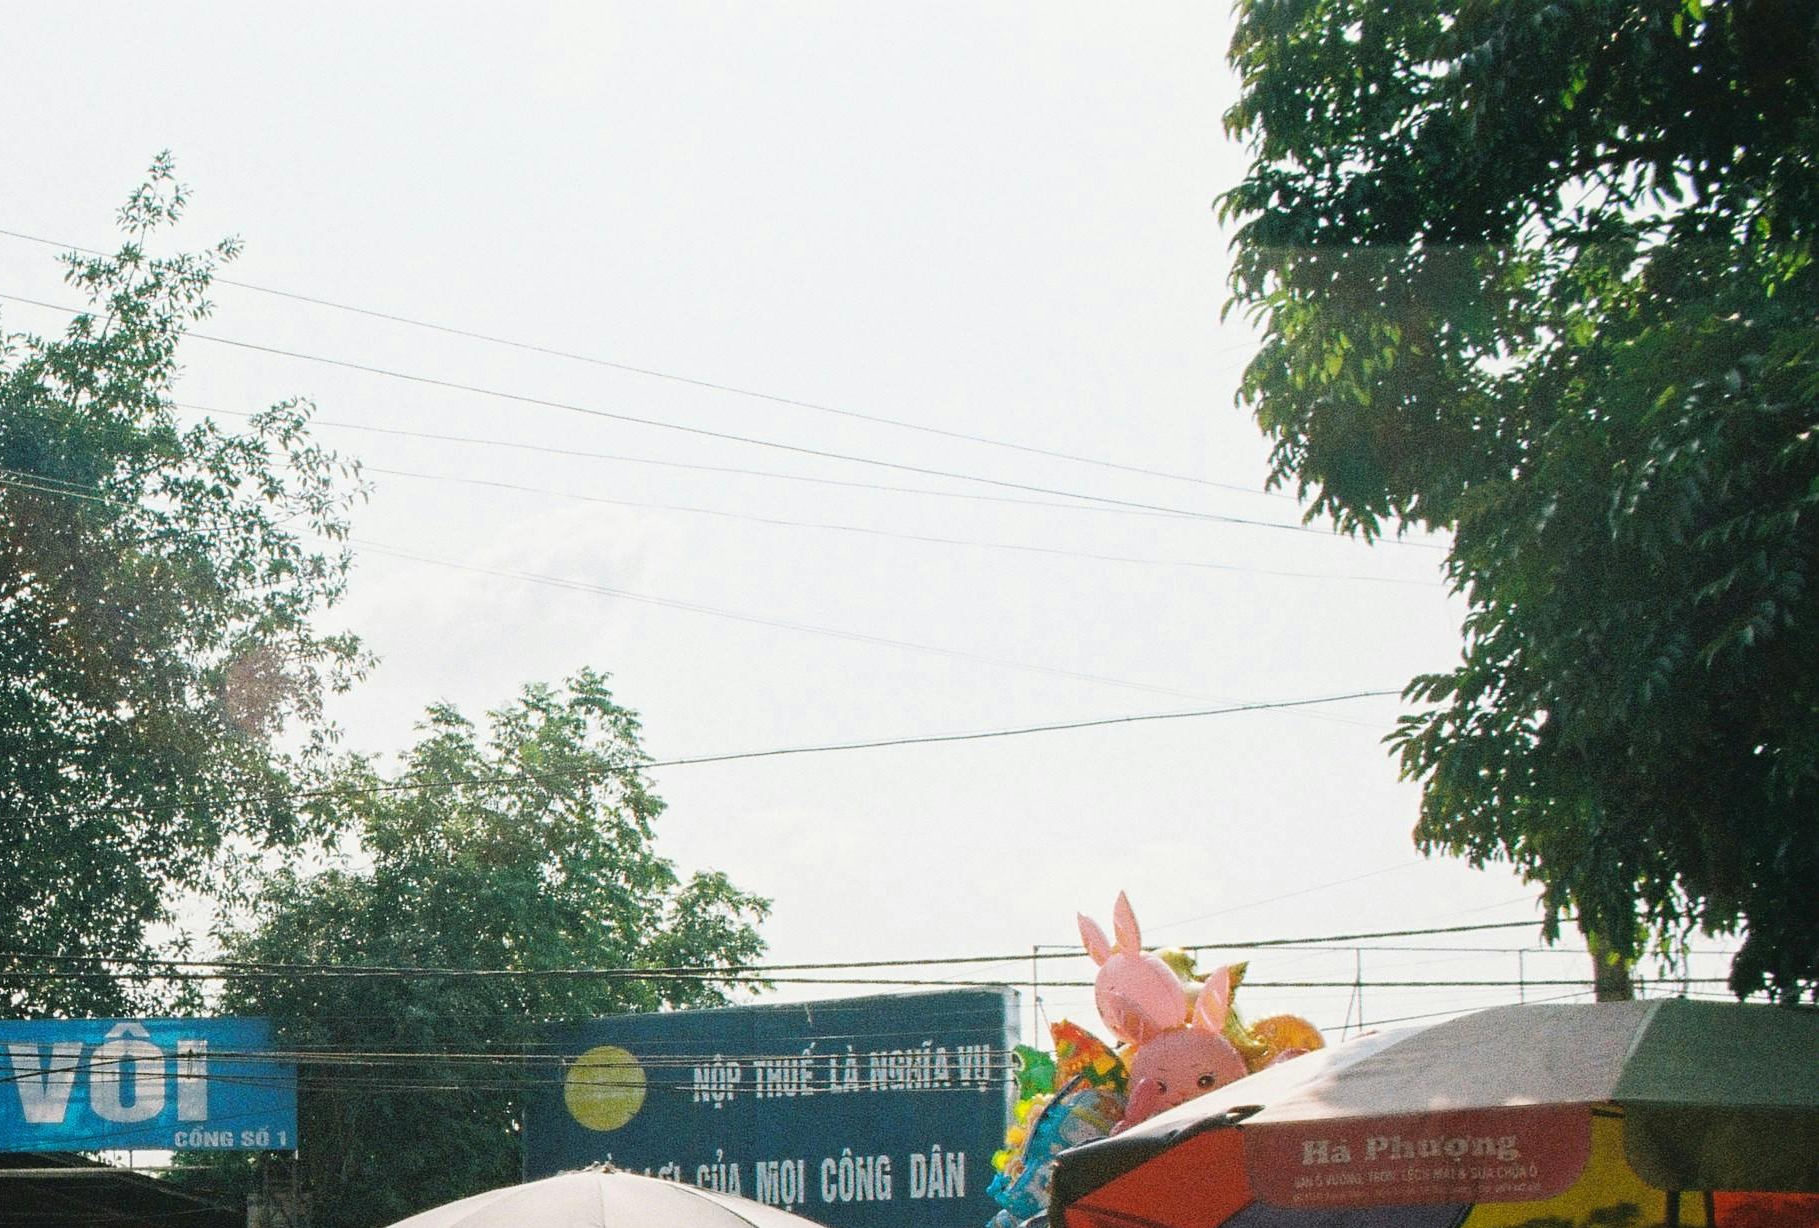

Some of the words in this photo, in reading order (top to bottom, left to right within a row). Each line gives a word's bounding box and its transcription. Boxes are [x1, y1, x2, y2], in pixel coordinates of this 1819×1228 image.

[8, 1022, 209, 1124] VÔI
[693, 1053, 742, 1109] NỘP
[753, 1042, 814, 1098] THUẾ
[829, 1044, 860, 1093] LÀ
[869, 1040, 951, 1091] NGHĨA
[957, 1043, 989, 1093] VỤ
[277, 1131, 287, 1147] 1
[756, 1158, 805, 1212] MỌI
[821, 1147, 892, 1203] CÔNG
[909, 1144, 965, 1199] DÂN
